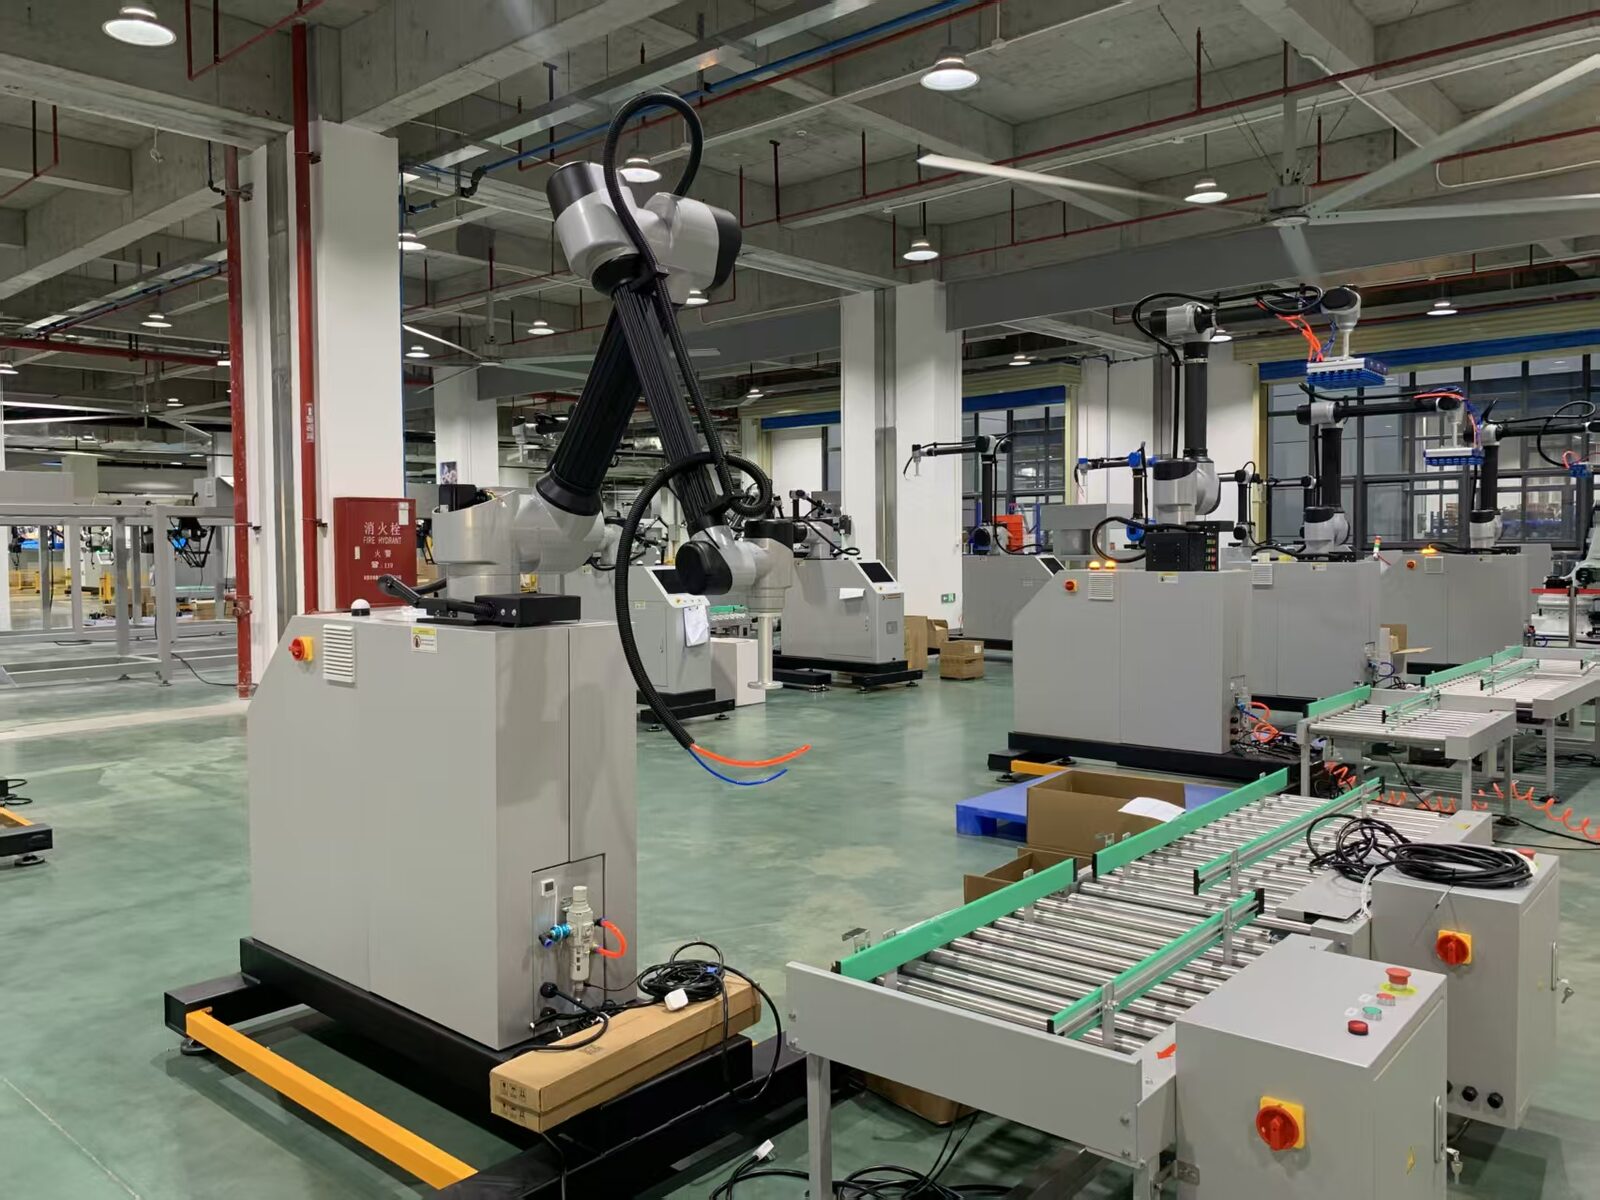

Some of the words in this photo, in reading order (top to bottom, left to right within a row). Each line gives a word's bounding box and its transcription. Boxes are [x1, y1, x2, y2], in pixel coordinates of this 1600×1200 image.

[363, 521, 401, 535] 消火栓
[363, 536, 376, 544] FIRE
[378, 536, 402, 544] HYDRANT
